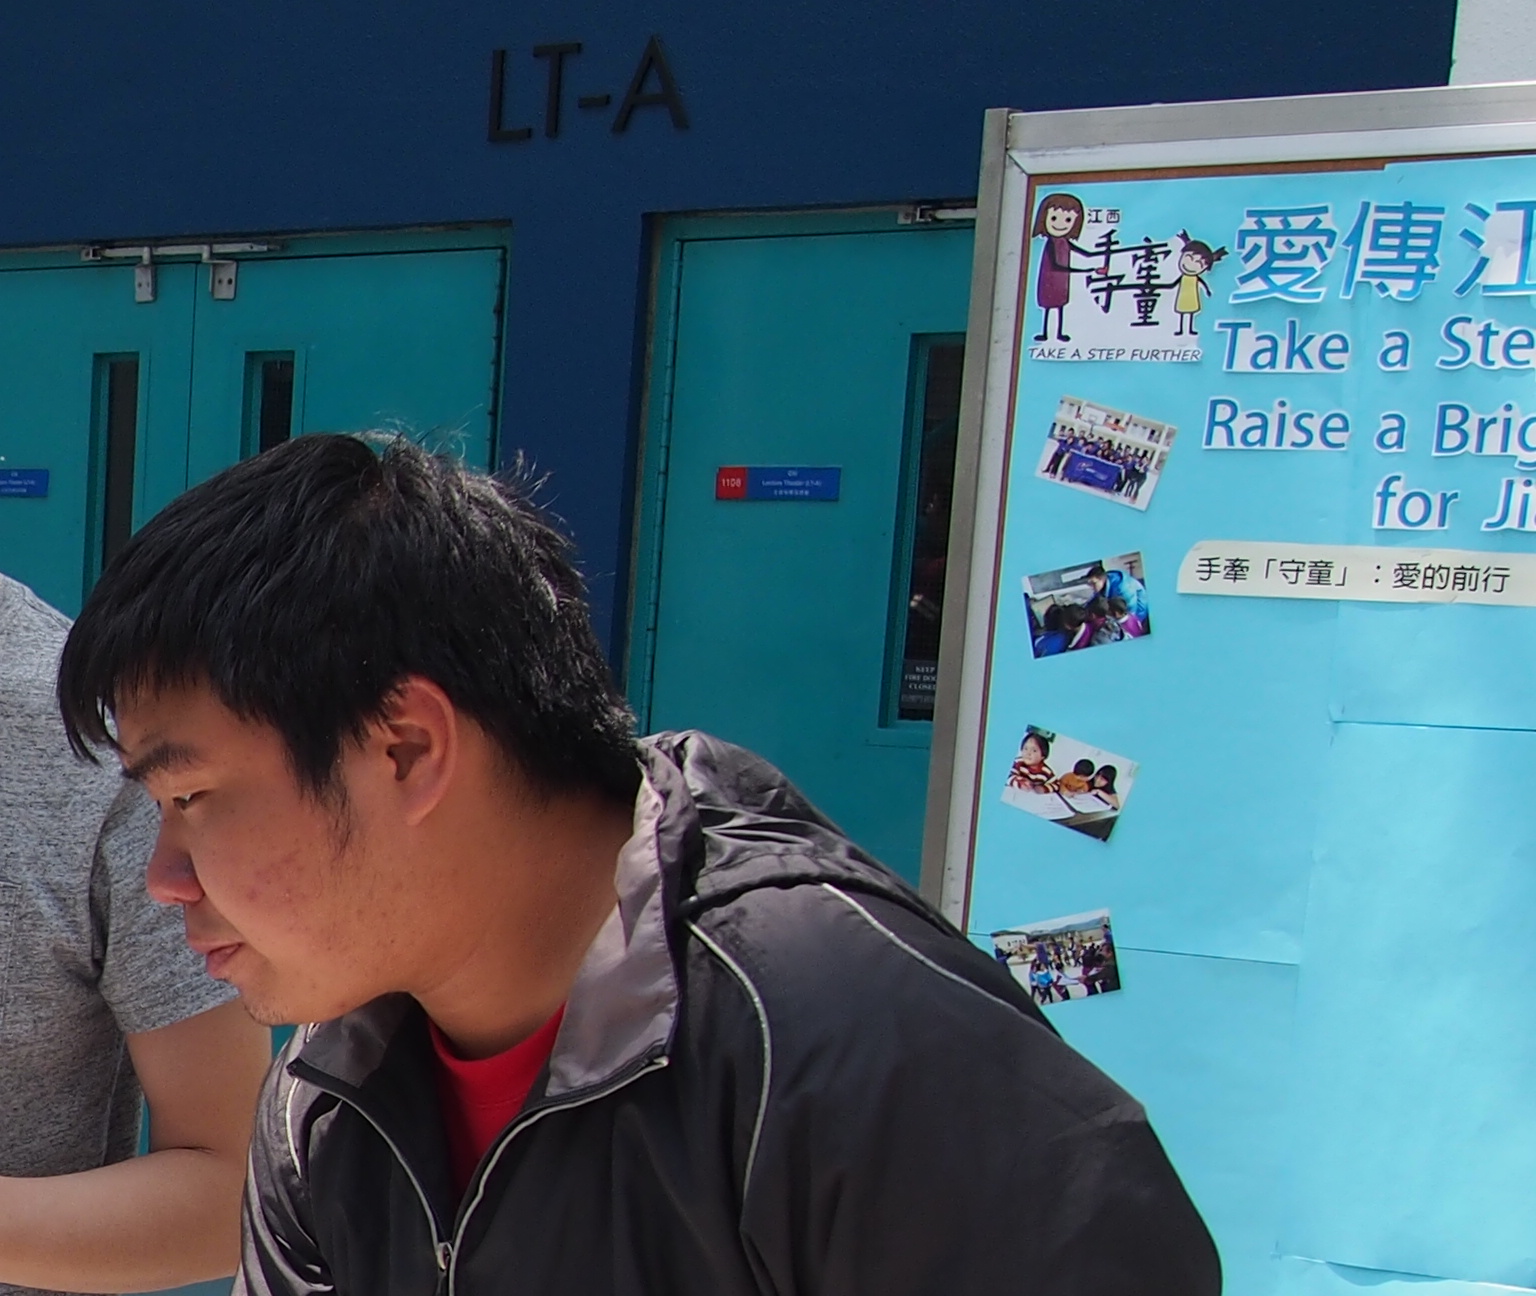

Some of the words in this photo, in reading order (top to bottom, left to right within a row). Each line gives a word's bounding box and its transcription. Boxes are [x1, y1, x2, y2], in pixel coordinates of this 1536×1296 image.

[487, 34, 690, 143] LT-A
[1087, 209, 1121, 225] 江西
[1029, 348, 1067, 360] TAKE
[1070, 349, 1083, 360] A
[1087, 348, 1126, 360] STEP
[1130, 349, 1201, 361] FURTHER
[1217, 320, 1349, 371] Take
[1379, 329, 1410, 369] a
[1204, 398, 1351, 449] Raise
[1375, 411, 1406, 451] a
[1376, 475, 1459, 529] for
